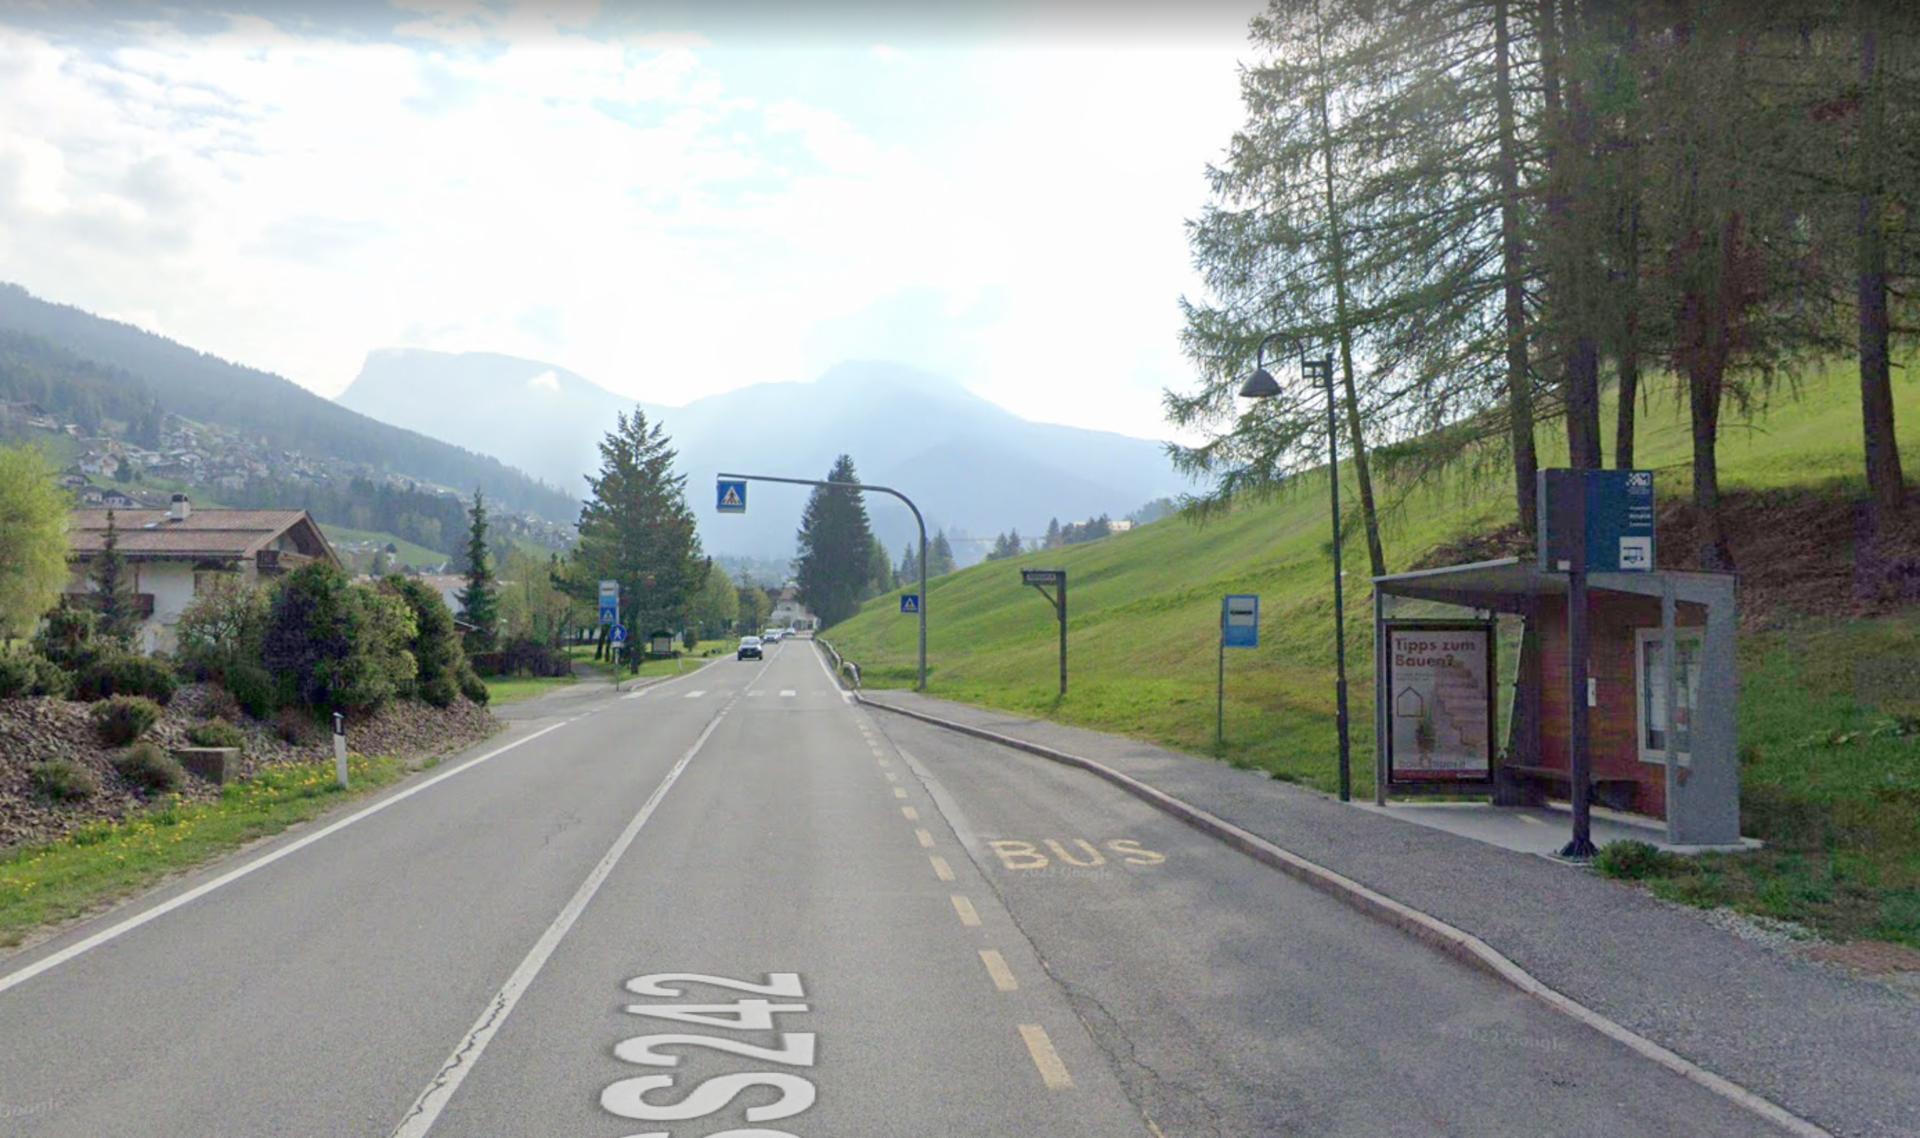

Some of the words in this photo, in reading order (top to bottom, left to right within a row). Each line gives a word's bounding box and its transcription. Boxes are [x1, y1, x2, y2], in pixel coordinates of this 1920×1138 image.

[1395, 638, 1437, 654] Tipps
[1442, 640, 1476, 651] zum
[1395, 654, 1454, 667] Bauen?
[988, 838, 1166, 870] BUS
